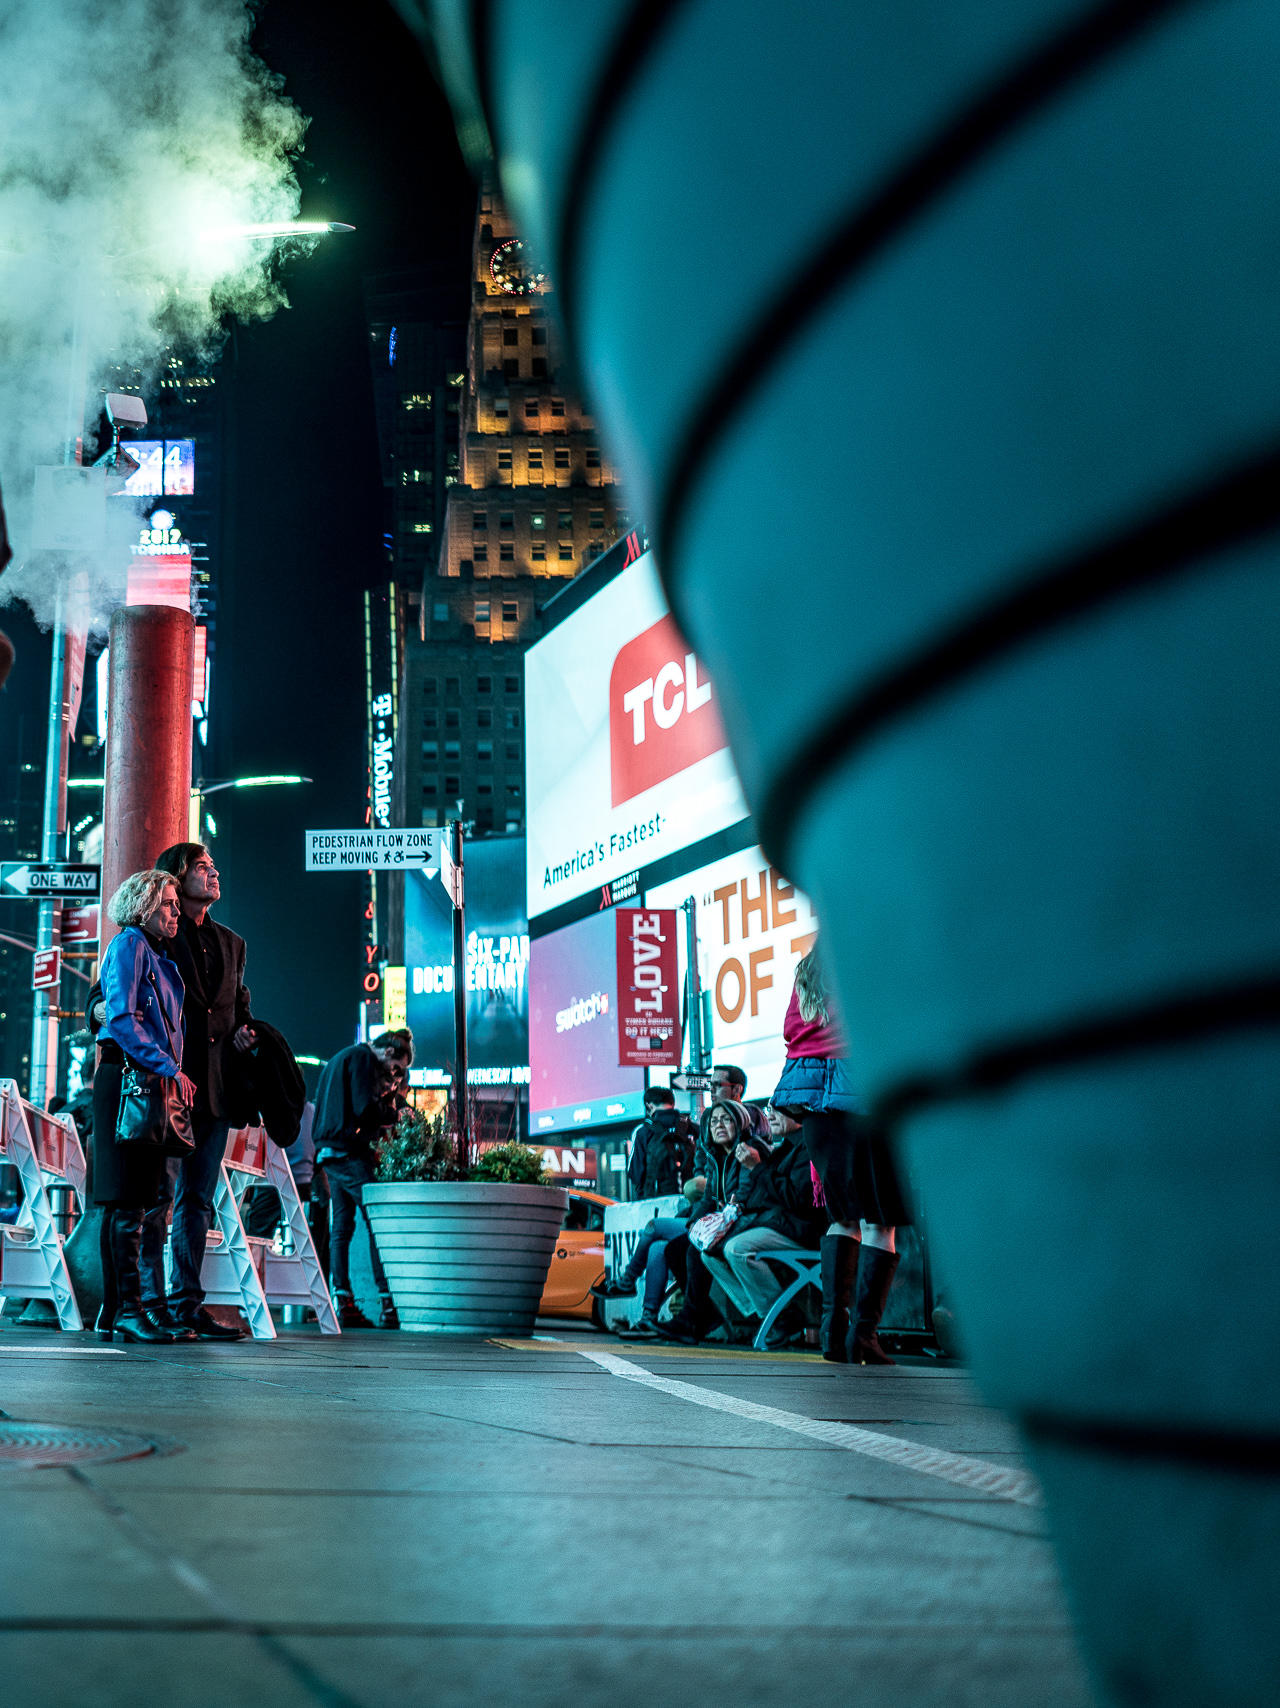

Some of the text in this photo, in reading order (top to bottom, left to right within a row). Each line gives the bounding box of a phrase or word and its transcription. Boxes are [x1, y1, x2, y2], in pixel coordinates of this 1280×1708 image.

[140, 529, 181, 545] 2017
[131, 543, 190, 556] TOSHIBA
[623, 652, 712, 746] TCL
[312, 833, 433, 849] PEDESTRIAN FLOW ZONE
[312, 851, 379, 865] KEEP MOVING
[543, 841, 605, 889] America's
[30, 873, 93, 888] ONE WAY
[632, 913, 663, 1013] LOVE
[715, 945, 774, 1024] OF
[555, 992, 601, 1034] swatch
[687, 1076, 704, 1088] ONE
